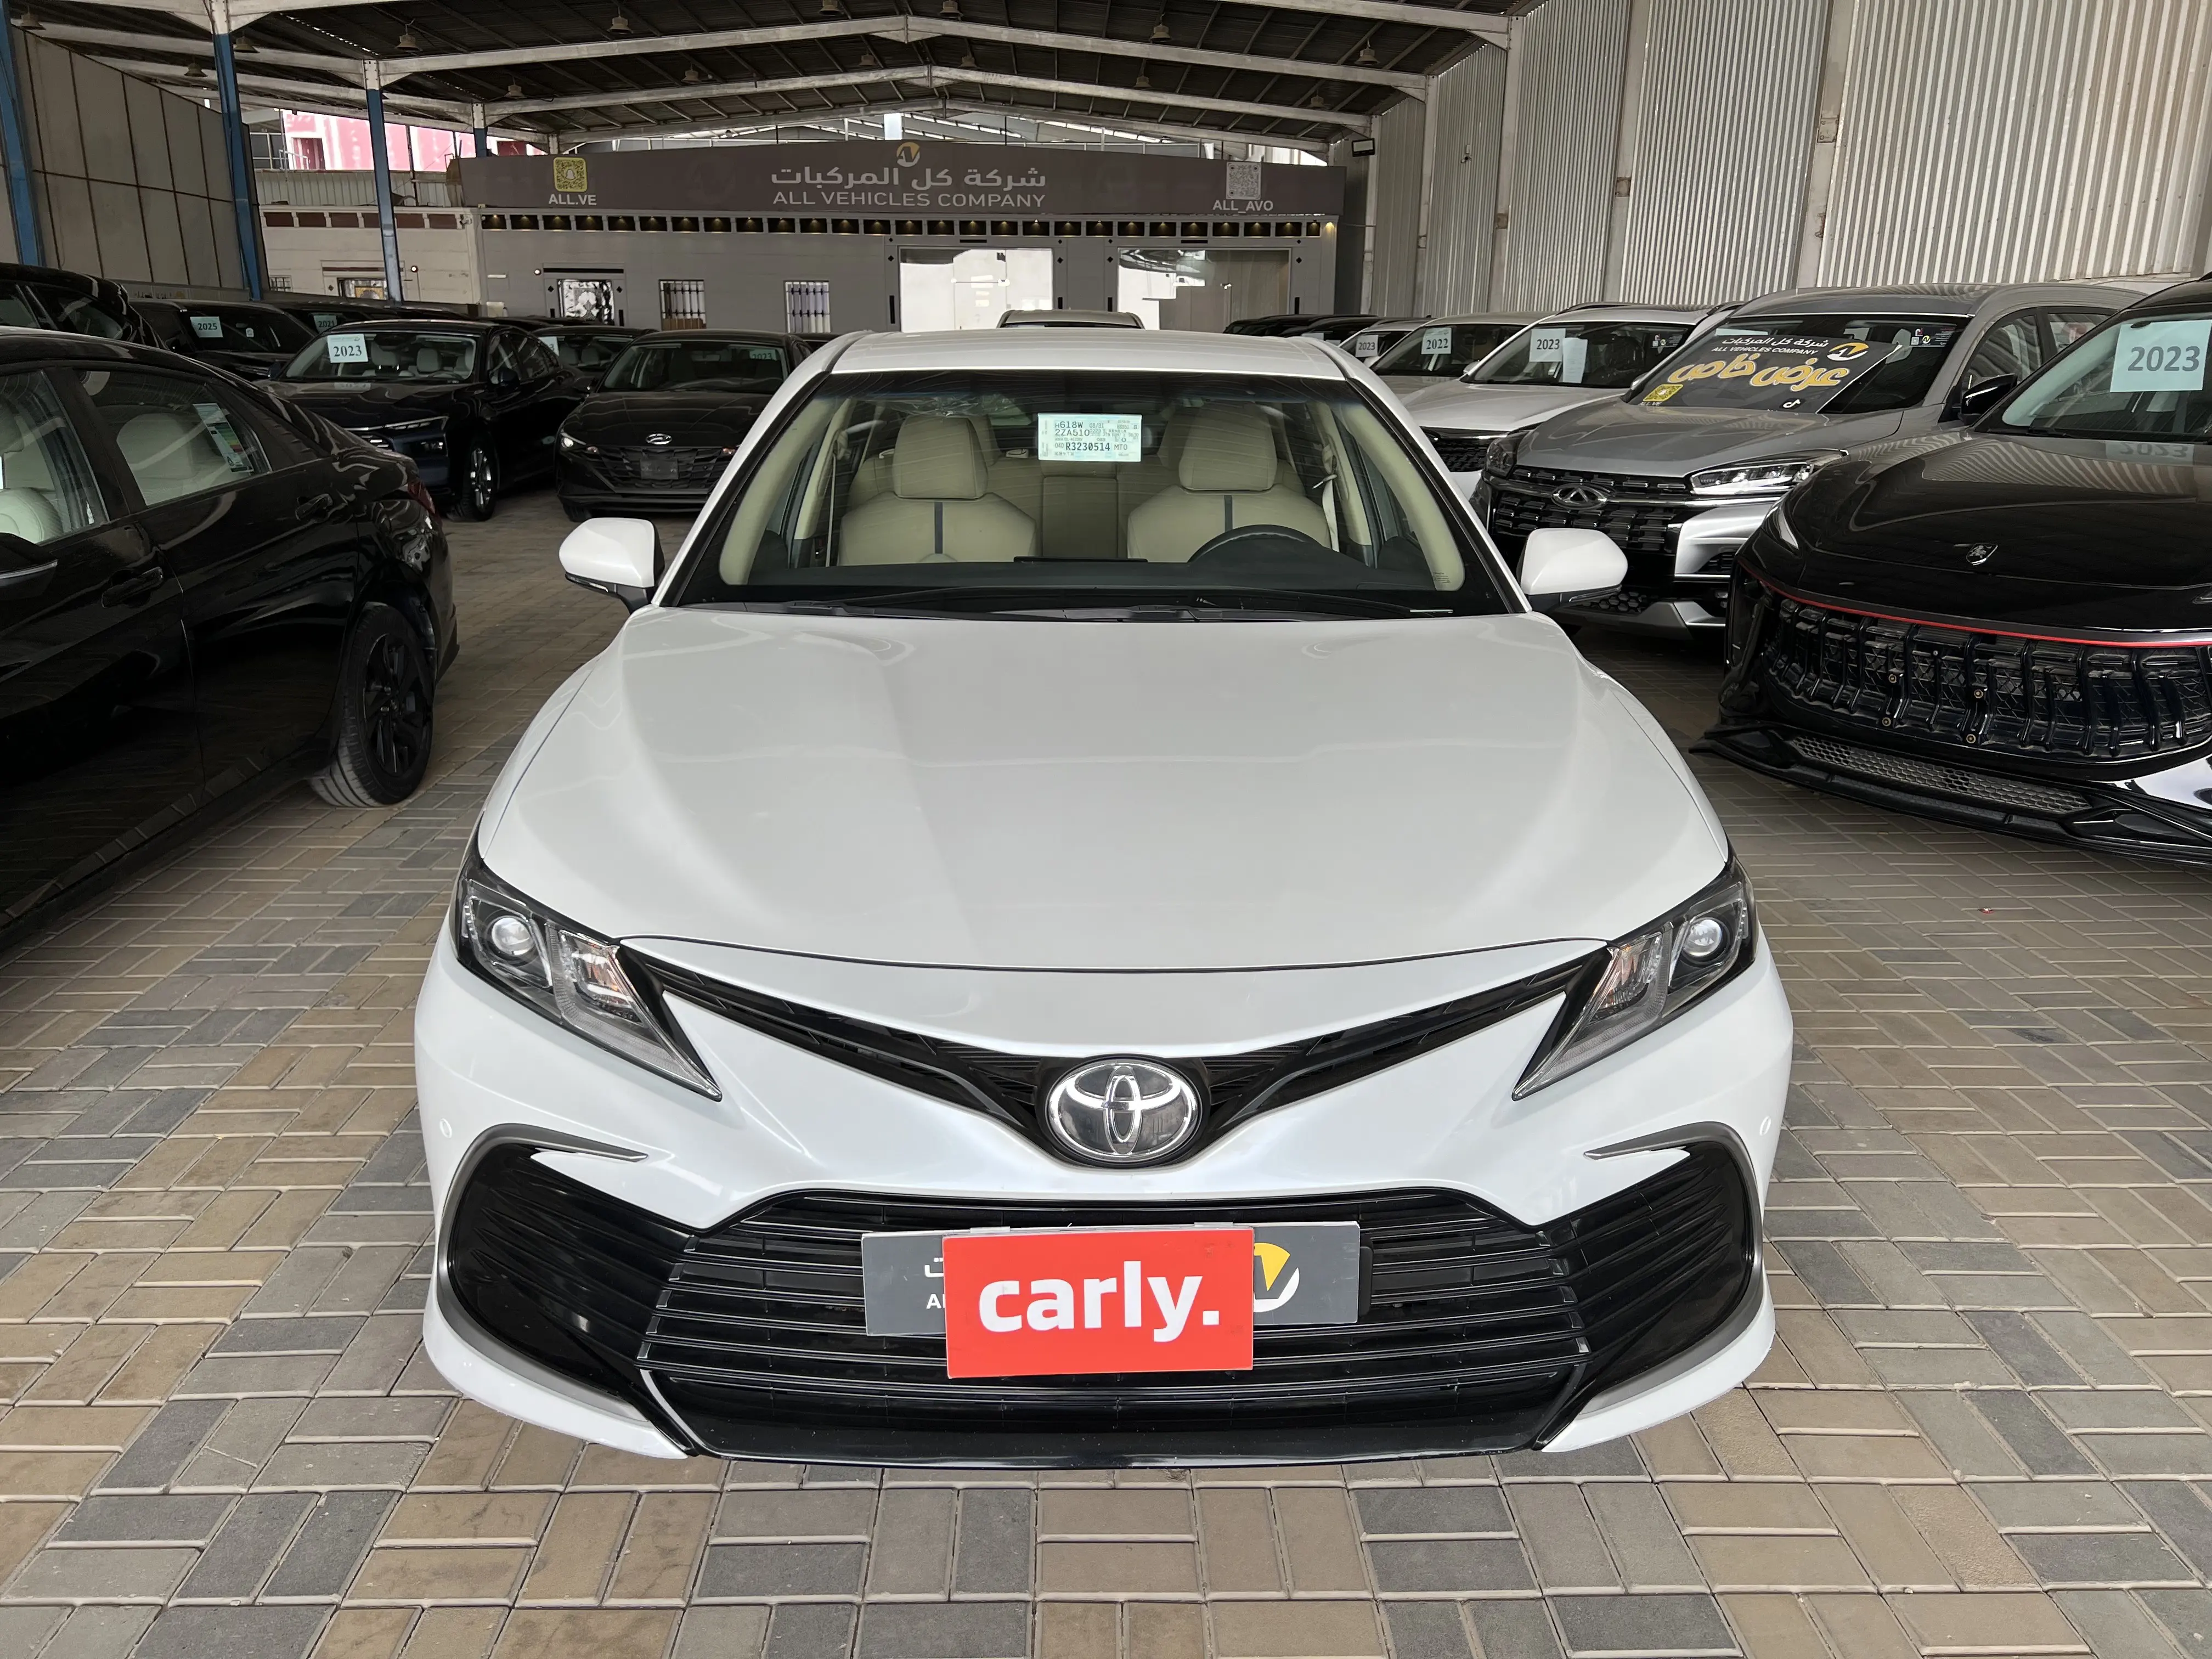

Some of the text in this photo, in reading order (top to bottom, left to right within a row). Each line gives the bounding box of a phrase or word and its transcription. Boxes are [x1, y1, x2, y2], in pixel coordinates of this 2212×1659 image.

[771, 166, 1046, 191] شركة كل المركبات
[548, 193, 597, 206] ALL.VE
[772, 191, 1046, 208] ALL VEHICLES COMPANY
[1212, 199, 1274, 213] ALL_AVO
[1358, 342, 1376, 351] 2023
[1426, 338, 1449, 349] 2022
[1536, 338, 1560, 350] 2023
[1722, 337, 1829, 348] شركة كل المركبات
[333, 345, 363, 357] 2023
[2127, 346, 2200, 372] 2023
[1667, 353, 1850, 392] عرض خاص
[1065, 442, 1110, 451] R3230514
[978, 1260, 1220, 1343] carly.
